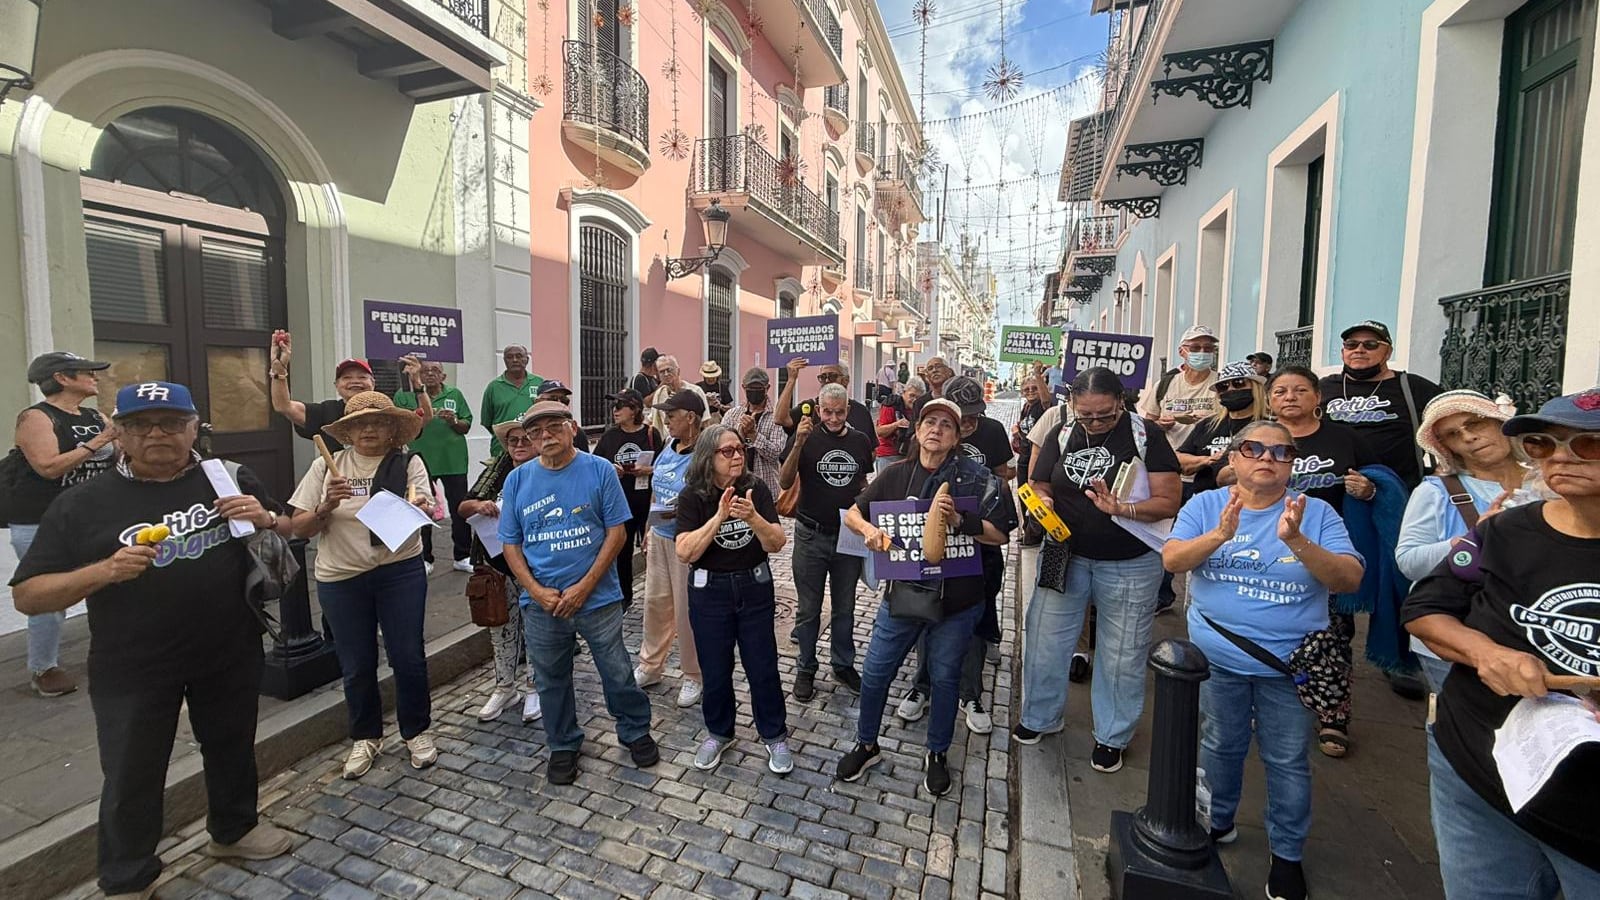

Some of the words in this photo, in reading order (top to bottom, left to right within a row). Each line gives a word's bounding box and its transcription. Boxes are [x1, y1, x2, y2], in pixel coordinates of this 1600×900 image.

[371, 310, 457, 328] PENSIONADA
[383, 322, 402, 334] EN
[406, 324, 428, 336] PIE
[431, 326, 448, 337] DE
[770, 325, 834, 337] PENSIONADOS
[1008, 331, 1051, 341] JUSTICIA
[393, 333, 440, 347] LUCHA
[770, 337, 780, 345] EN
[782, 334, 834, 344] SOLIDARIDAD
[1006, 339, 1031, 348] PARA
[1034, 340, 1054, 350] LAS
[778, 344, 786, 354] Y
[789, 341, 826, 353] LUCHA
[1003, 346, 1055, 357] PENSIONADAS
[1072, 339, 1145, 360] RETIRO
[137, 383, 169, 401] PR
[1326, 395, 1391, 414] Retiro
[1211, 436, 1232, 445] GAN
[1292, 455, 1334, 474] iro
[1288, 473, 1344, 492] igno
[523, 493, 556, 516] DEFIENDE
[878, 513, 895, 526] ES
[528, 534, 536, 542] LA
[538, 525, 591, 541] EDUCACIÓN
[550, 536, 592, 552] PÚBLICA
[901, 537, 912, 549] Y
[890, 549, 906, 561] DE
[1542, 642, 1591, 674] RETIRO
